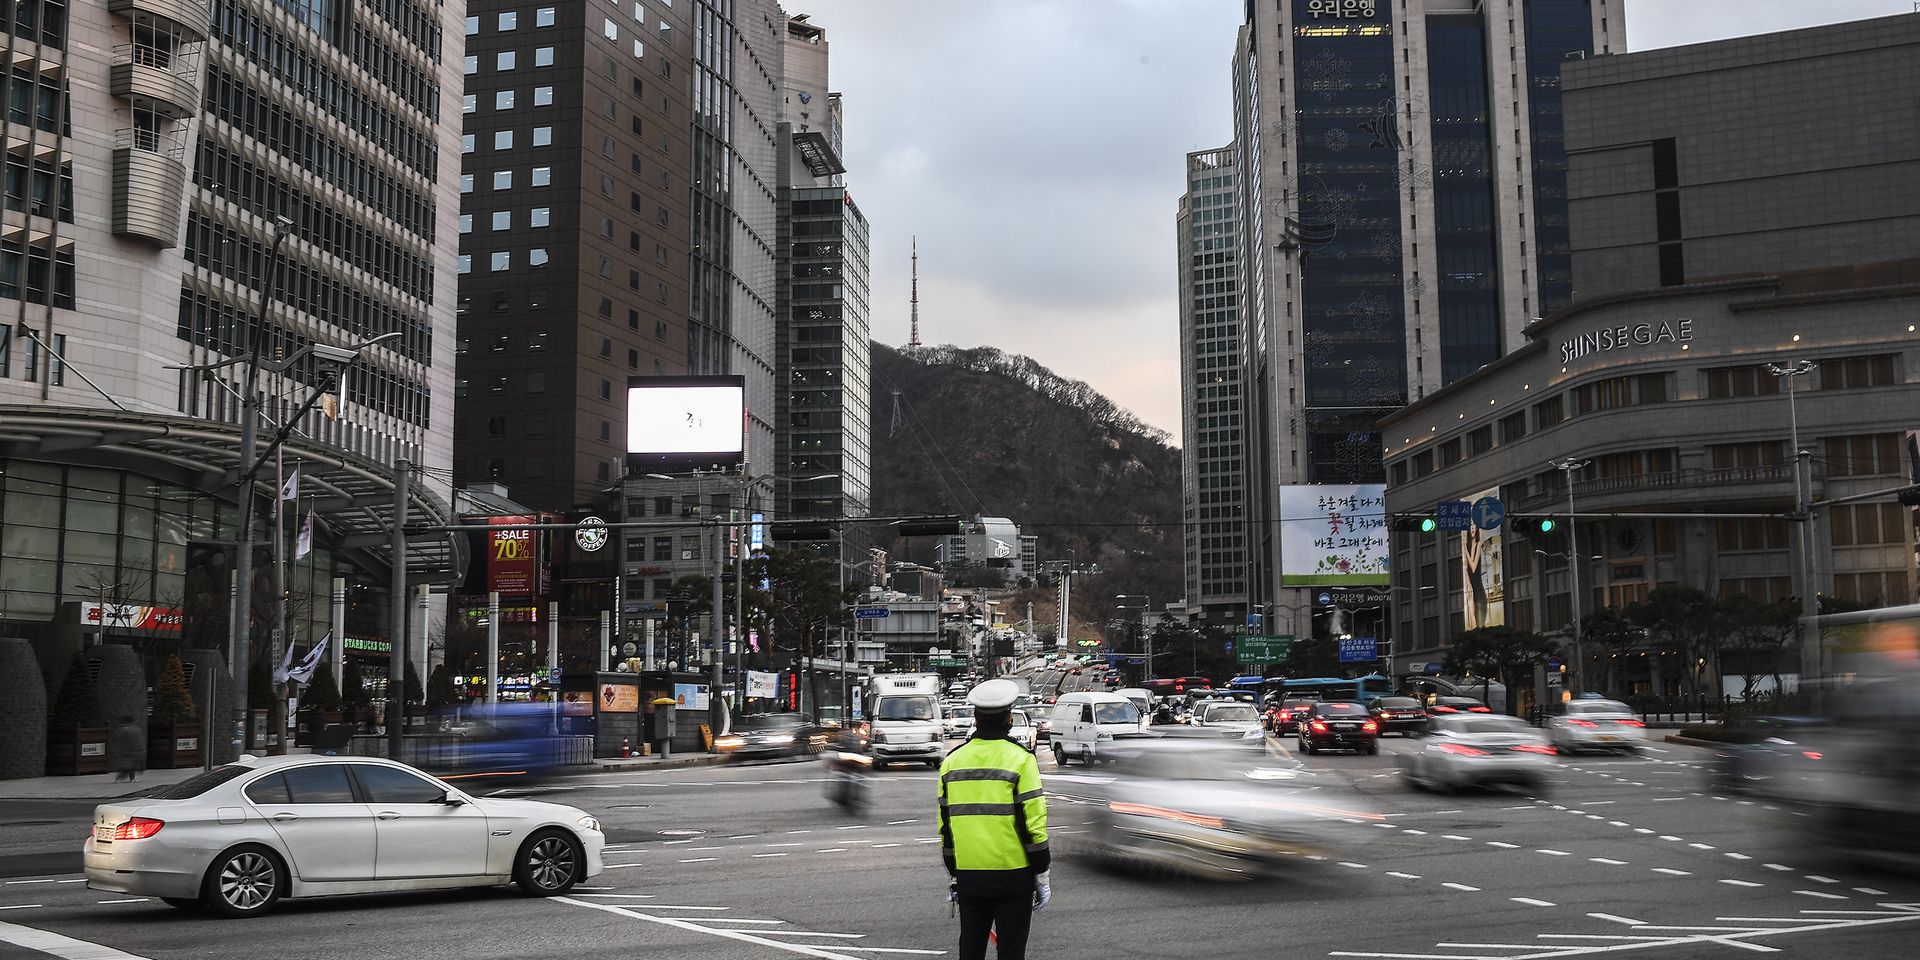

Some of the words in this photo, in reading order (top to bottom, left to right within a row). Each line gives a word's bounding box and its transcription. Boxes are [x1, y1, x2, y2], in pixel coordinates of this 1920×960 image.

[1308, 0, 1375, 18] 우리은행
[1560, 318, 1693, 364] SHINSEGAE
[1318, 496, 1336, 510] 추운
[1338, 495, 1358, 511] 겨울
[494, 539, 529, 559] 70%
[579, 537, 604, 549] COFFEE
[1315, 537, 1335, 549] 바로
[1338, 538, 1359, 548] 그대
[1362, 536, 1383, 550] 앞에
[344, 638, 377, 651] STARBUCKS
